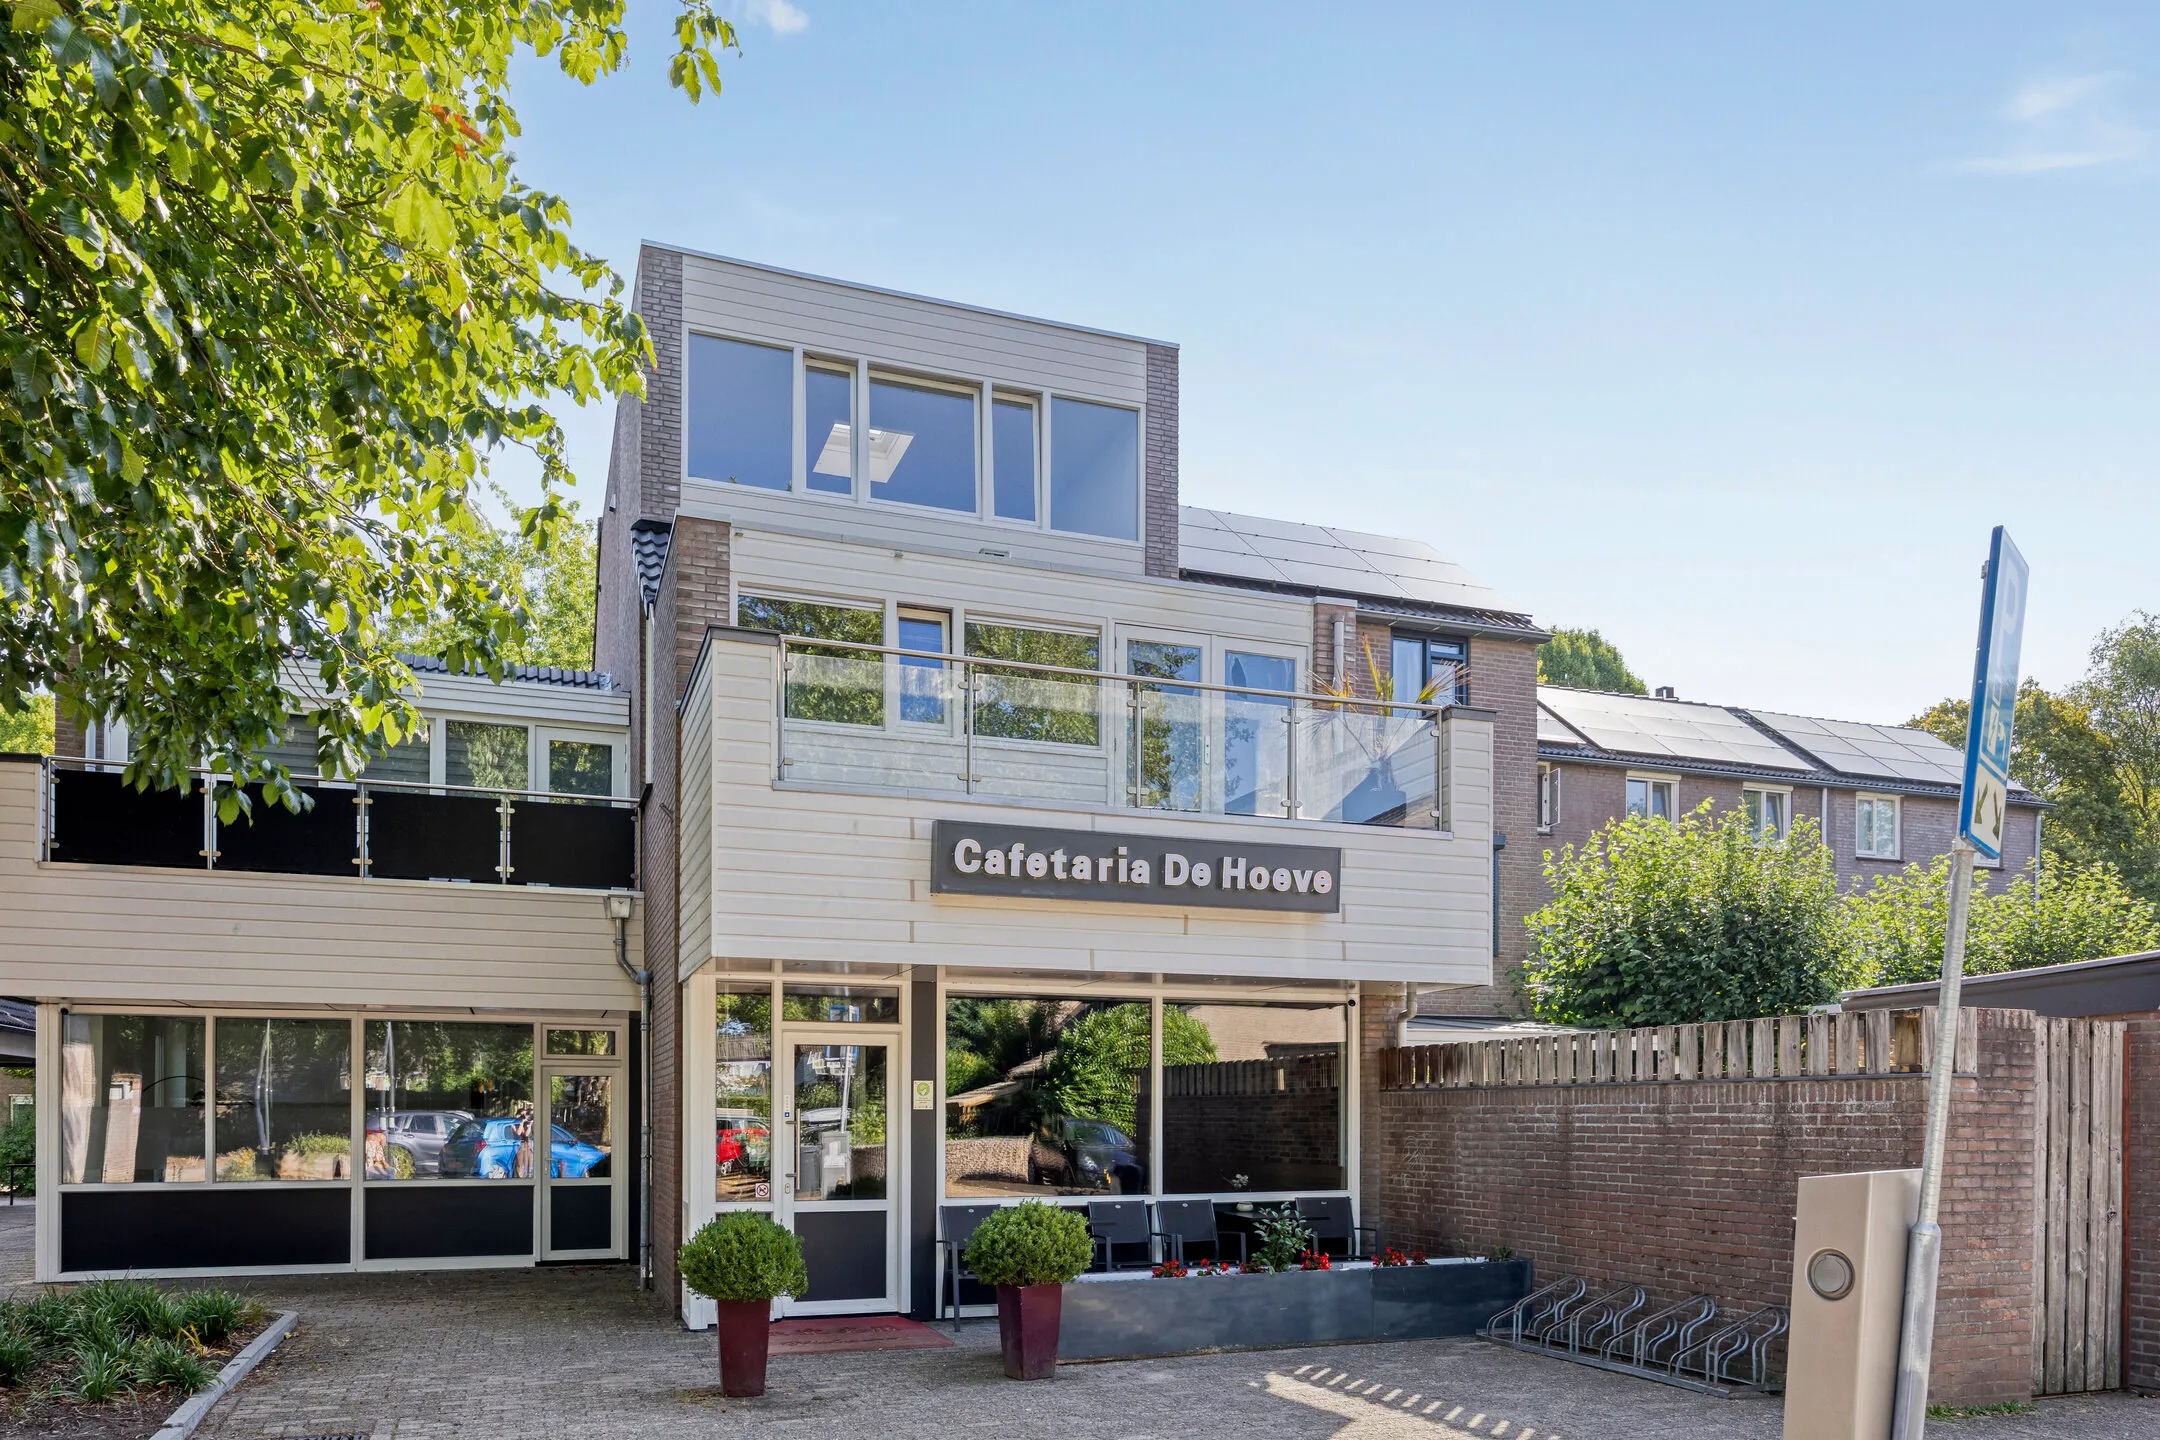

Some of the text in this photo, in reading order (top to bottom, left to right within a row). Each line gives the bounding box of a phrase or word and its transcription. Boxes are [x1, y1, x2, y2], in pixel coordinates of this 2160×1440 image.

[1996, 557, 2020, 670] P
[953, 838, 1333, 895] Cafetaria De Hoeve
